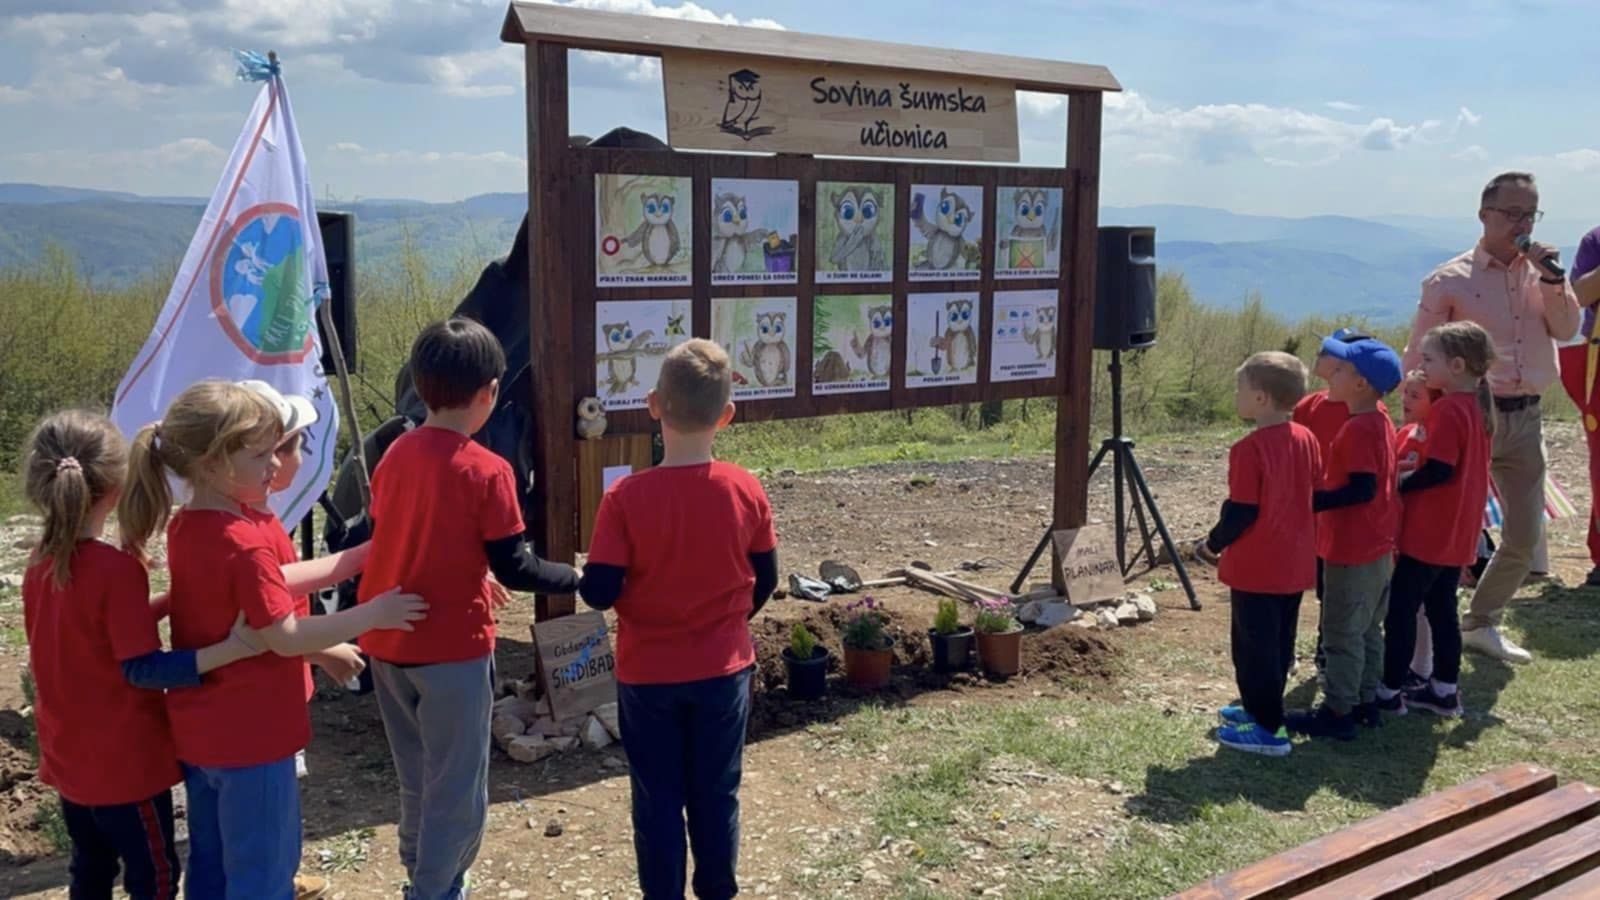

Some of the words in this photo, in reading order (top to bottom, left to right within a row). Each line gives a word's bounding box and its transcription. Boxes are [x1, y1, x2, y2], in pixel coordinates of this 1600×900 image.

[810, 77, 892, 107] Sovina
[899, 83, 986, 113] šumska
[860, 120, 948, 149] učionica
[1076, 545, 1098, 557] MALI
[551, 653, 615, 689] SINDIBAD
